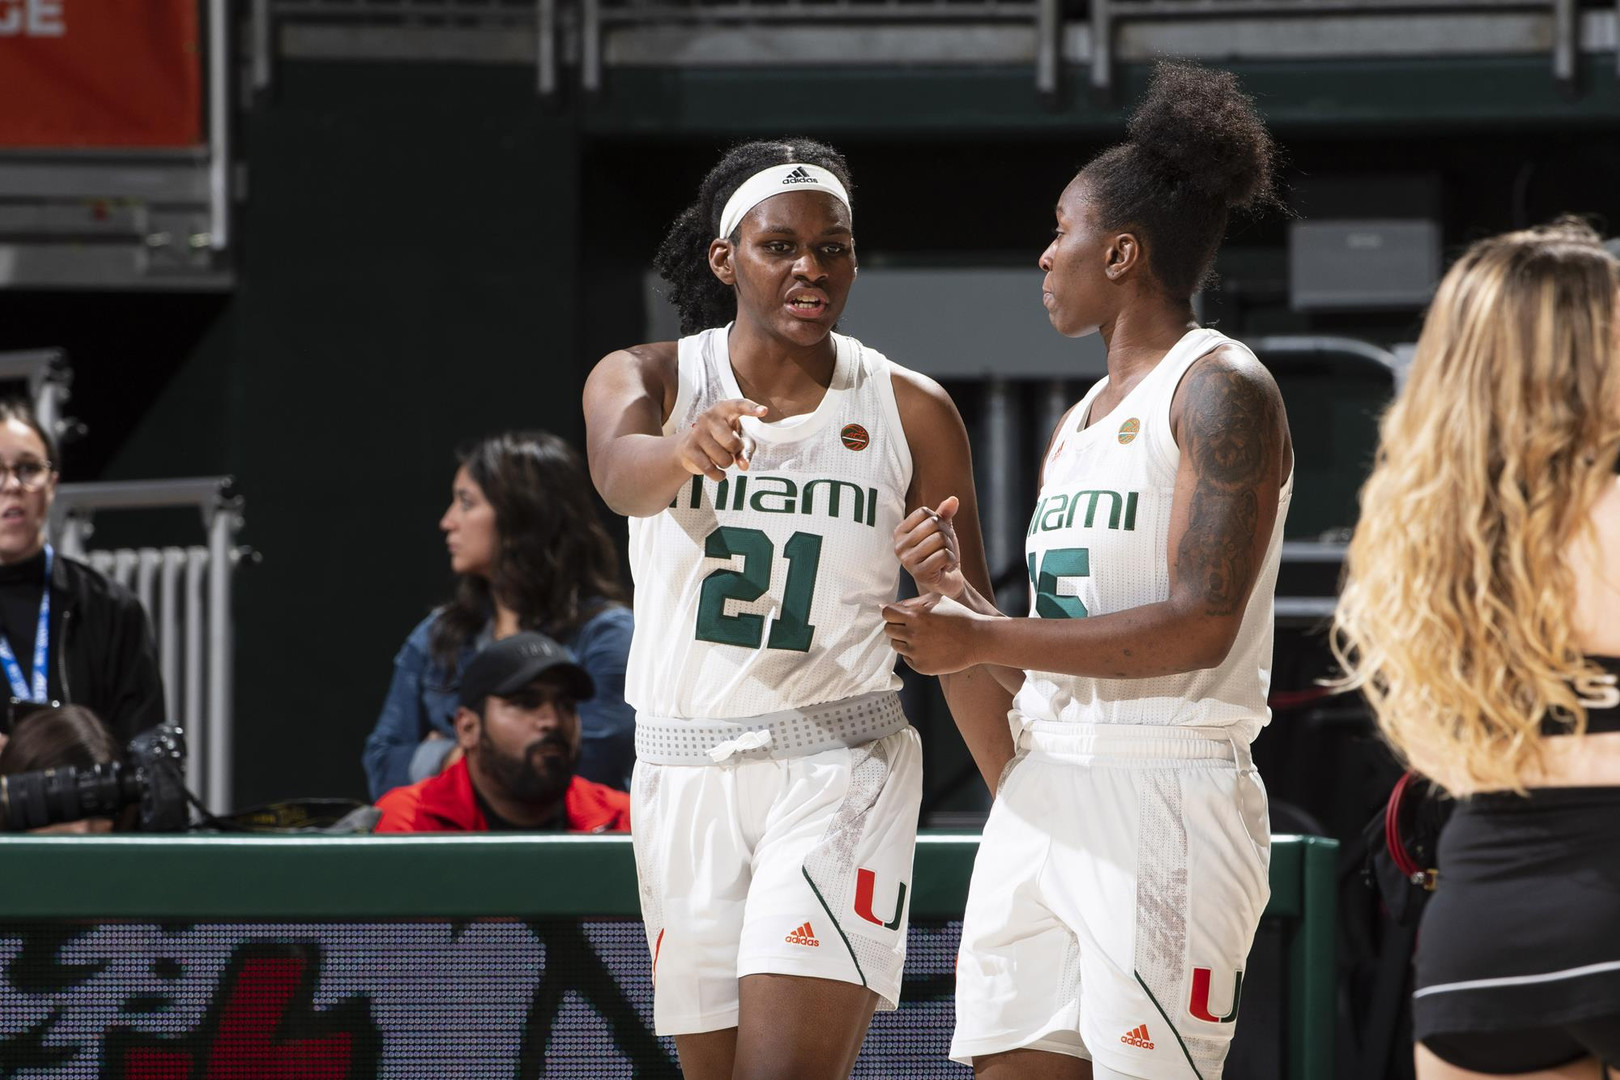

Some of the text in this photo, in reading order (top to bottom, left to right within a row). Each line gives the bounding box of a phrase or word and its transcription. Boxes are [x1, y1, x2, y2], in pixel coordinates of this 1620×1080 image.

[782, 177, 819, 185] adidas
[695, 526, 823, 652] 21
[854, 868, 907, 931] U
[785, 935, 820, 947] adidas
[1189, 968, 1243, 1023] U
[1120, 1035, 1155, 1050] adidas
